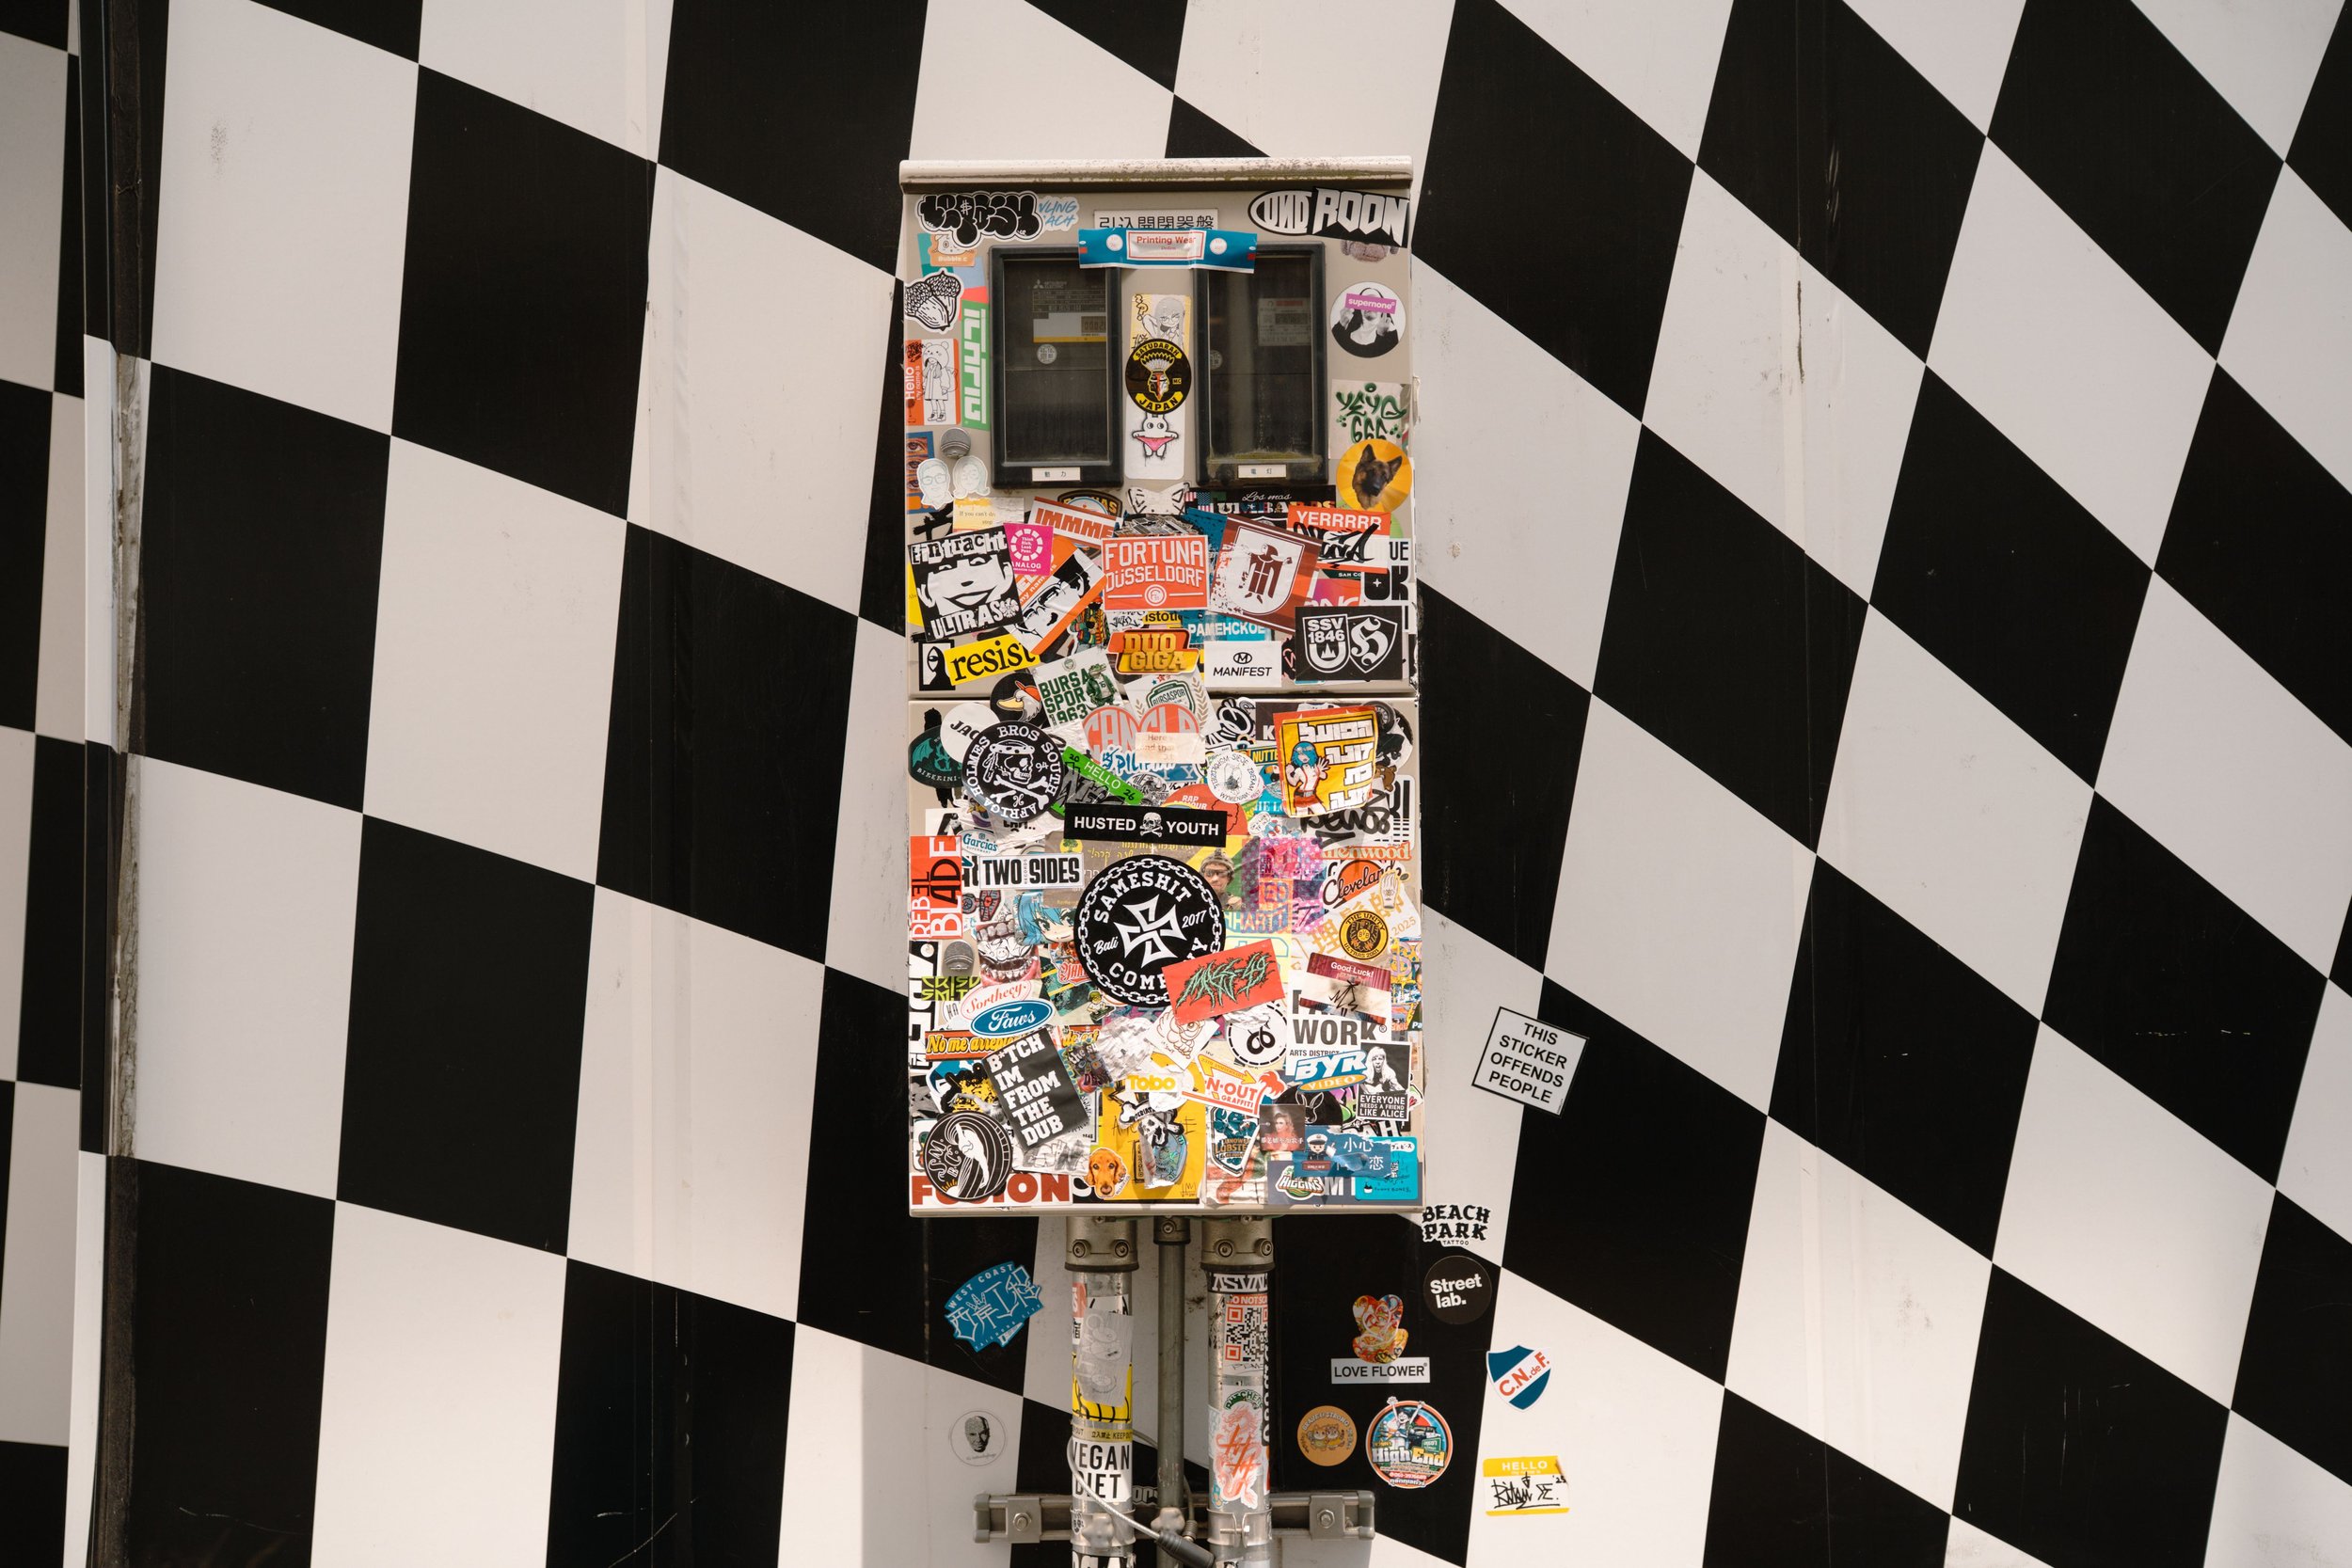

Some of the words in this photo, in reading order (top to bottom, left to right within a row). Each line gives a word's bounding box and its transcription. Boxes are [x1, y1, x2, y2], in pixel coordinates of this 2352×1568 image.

[1136, 236, 1173, 245] Printing
[1135, 341, 1180, 357] SATUDARAH
[905, 366, 915, 400] Hello
[1139, 397, 1179, 411] JAPAN
[1242, 491, 1265, 501] Los
[912, 530, 1008, 564] Eintracht
[1104, 540, 1205, 570] FORTUNA
[1105, 565, 1205, 593] DÜSSELDORF
[930, 599, 1004, 640] ULTRAS
[1188, 621, 1265, 638] РАМЕНСКОЕ
[1308, 617, 1344, 631] SSV
[1123, 632, 1177, 654] DUO
[1308, 629, 1345, 644] 1846
[950, 640, 1036, 681] resist
[1130, 651, 1187, 671] GIGA
[1038, 668, 1090, 694] BURSA
[1213, 666, 1272, 677] MANIFEST
[1042, 687, 1087, 714] SPOR
[997, 725, 1041, 742] BROS
[966, 736, 991, 798] HOLMES
[1036, 761, 1049, 772] 94
[1069, 753, 1080, 763] 20
[1041, 742, 1061, 797] SOUTH
[1084, 759, 1122, 789] HELLO
[1122, 788, 1136, 800] 26
[983, 797, 1038, 820] AFRICA
[1073, 816, 1136, 832] HUSTED
[1166, 820, 1219, 836] YOUTH
[982, 858, 1022, 885] TWO
[1028, 857, 1080, 884] SIDES
[930, 836, 962, 937] BLADE
[912, 871, 930, 938] REBEL
[1093, 871, 1192, 923] SAMESHIT
[1182, 910, 1207, 928] 2017
[1345, 912, 1362, 925] THE
[1363, 912, 1386, 931] UNITY
[1392, 917, 1417, 936] 2025
[1093, 936, 1119, 955] Bali
[1343, 942, 1366, 958] ULTRAS
[1330, 961, 1352, 973] Good
[1352, 965, 1375, 977] Luck!
[988, 1006, 1036, 1032] Faws
[1293, 1019, 1376, 1046] WORK
[1524, 1022, 1558, 1045] THIS
[926, 1035, 946, 1053] No
[947, 1038, 970, 1053] me
[1499, 1035, 1568, 1069] STICKER
[1068, 1048, 1086, 1064] the
[1295, 1051, 1367, 1081] BYR
[994, 1065, 1025, 1090] IM
[1490, 1052, 1565, 1087] OFFENDS
[1003, 1070, 1061, 1110] FROM
[1307, 1075, 1357, 1090] VIDEO
[1488, 1070, 1553, 1103] PEOPLE
[1221, 1095, 1254, 1108] GRAFFITI
[1359, 1095, 1406, 1105] EVERYONE
[1011, 1096, 1056, 1127] THE
[1021, 1115, 1064, 1147] DUB
[1216, 1144, 1248, 1155] LOBSTE
[1343, 1137, 1374, 1152] 小心
[1281, 1176, 1324, 1191] HIGGINS
[1422, 1204, 1491, 1223] BEACH
[1423, 1223, 1488, 1241] PARK
[947, 1283, 974, 1309] WEST
[977, 1263, 1014, 1283] COAST
[1430, 1274, 1483, 1294] Street
[1240, 1295, 1258, 1305] NOT
[1435, 1292, 1467, 1308] lab.
[1334, 1366, 1368, 1378] LOVE
[1372, 1365, 1424, 1377] FLOWER
[1372, 1447, 1411, 1465] High
[1411, 1447, 1445, 1467] End
[1502, 1461, 1548, 1471] HELLO
[1075, 1470, 1121, 1499] DIET
